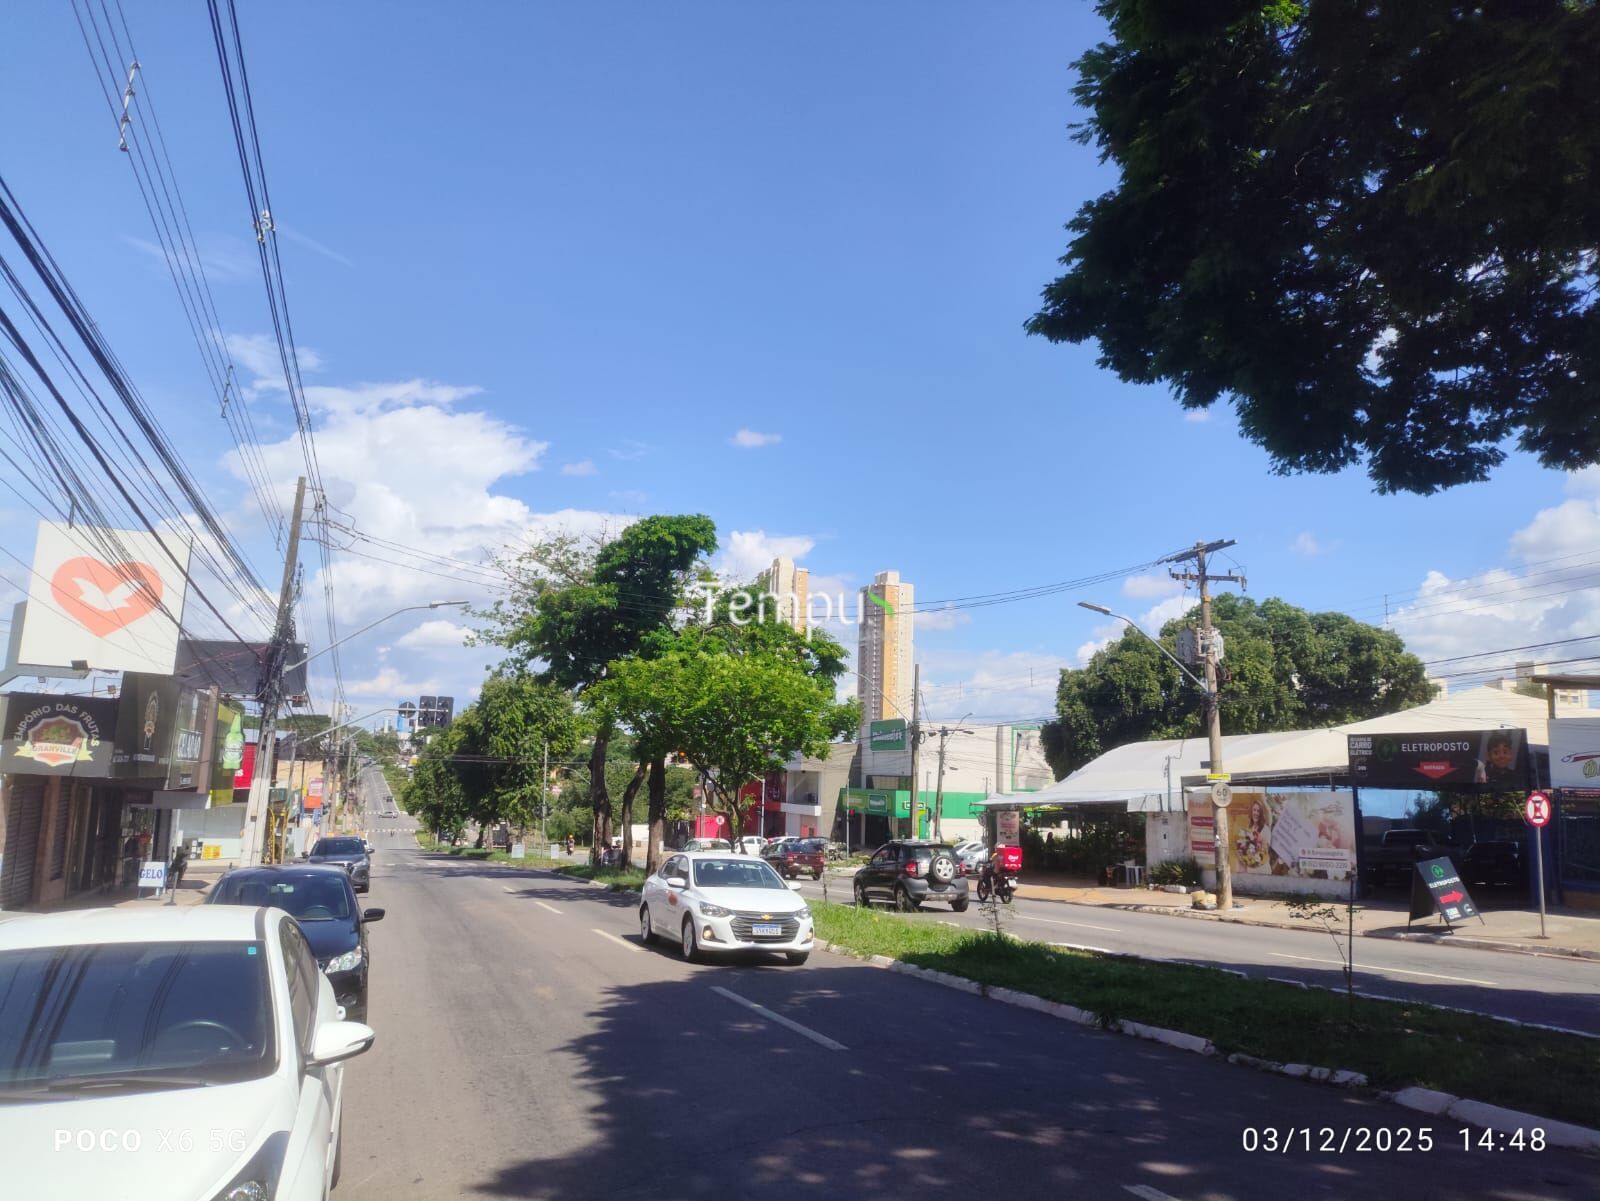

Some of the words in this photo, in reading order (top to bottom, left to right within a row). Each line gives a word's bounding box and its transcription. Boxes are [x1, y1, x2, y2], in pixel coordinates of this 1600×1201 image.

[14, 705, 51, 741] EMPÓRIO
[56, 703, 78, 714] DAS
[79, 711, 100, 747] FRUTAS
[1401, 742, 1470, 752] ELETROPOSTO
[1216, 787, 1228, 797] 60
[140, 869, 163, 879] GELO
